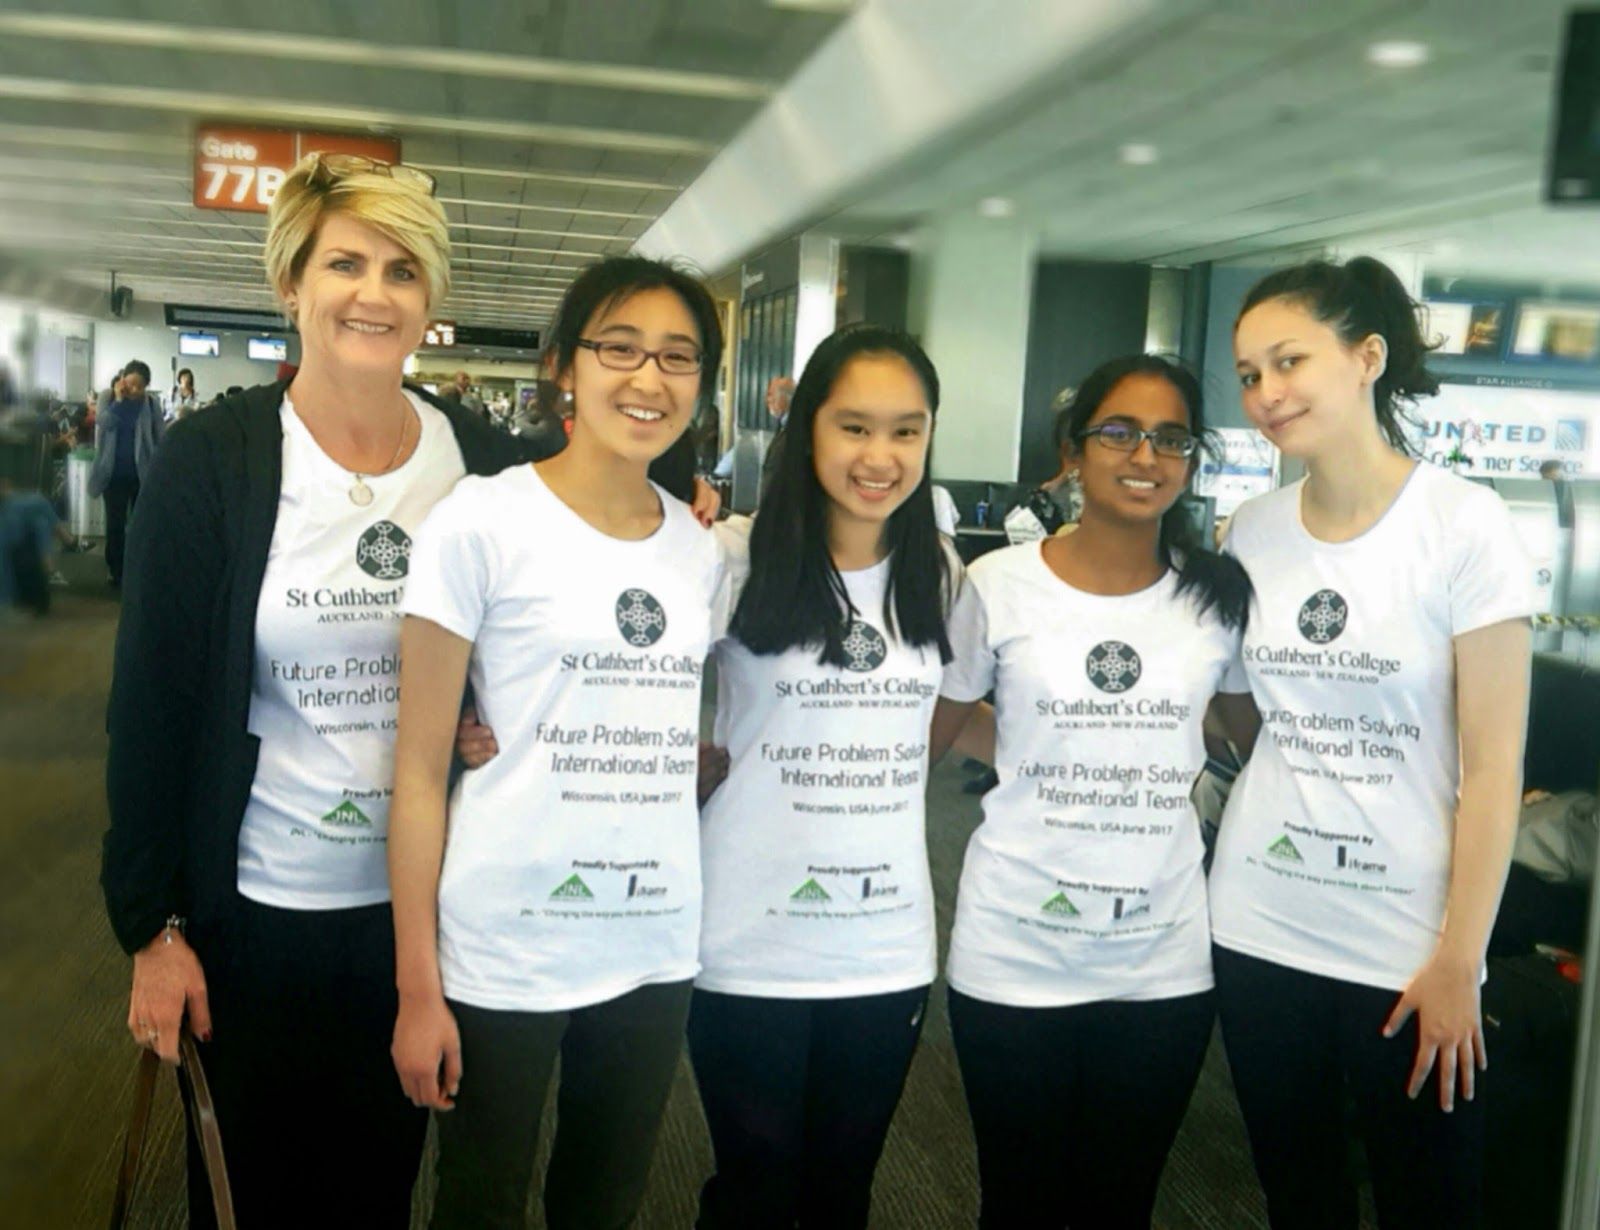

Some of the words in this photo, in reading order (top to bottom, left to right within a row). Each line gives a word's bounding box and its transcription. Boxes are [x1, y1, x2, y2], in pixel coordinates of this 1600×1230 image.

[202, 136, 257, 161] Gate
[202, 163, 286, 206] 77B
[1476, 376, 1499, 386] STAR
[1500, 377, 1543, 388] ALLIANCE
[1431, 450, 1513, 471] Cumer
[1519, 454, 1584, 474] Seice
[286, 588, 308, 607] St
[317, 612, 383, 623] AUCKLAND
[560, 654, 578, 672] St
[583, 652, 657, 672] Cuthbert's
[1256, 645, 1336, 668] Cuthbert's
[1339, 650, 1401, 675] College
[271, 660, 337, 681] Future
[1260, 668, 1310, 679] AUCKLAND
[1337, 672, 1379, 685] ZEALAND
[583, 676, 629, 687] AUCKLAND
[656, 678, 696, 690] ZEALAND
[776, 680, 793, 698] St
[796, 678, 881, 697] Cuthbert's
[800, 700, 852, 709] AUCKLAND
[881, 699, 920, 709] ZEALAND
[1051, 699, 1133, 717] Cuthbert's
[536, 722, 587, 744] Future
[593, 725, 663, 747] Problem
[1054, 720, 1106, 730] AUCKLAND
[1134, 721, 1178, 730] ZEALAND
[1359, 714, 1421, 741] Solving
[762, 743, 811, 762] Future
[818, 743, 889, 762] Problem
[1359, 739, 1405, 762] Team
[551, 753, 656, 775] International
[1072, 763, 1142, 783] Problem
[780, 767, 885, 788] International
[1340, 769, 1364, 782] June
[1366, 773, 1393, 785] 2017
[343, 788, 382, 800] Proudly
[620, 790, 640, 802] USA
[640, 791, 660, 804] June
[661, 791, 682, 802] 2017
[1037, 782, 1138, 808] International
[1145, 791, 1188, 810] Team
[849, 802, 869, 814] USA
[869, 802, 890, 815] June
[1100, 822, 1121, 832] USA
[1122, 823, 1146, 835] June
[1148, 824, 1173, 836] 2017
[1283, 820, 1312, 837] Proudly
[1314, 828, 1360, 843] Supported
[1363, 834, 1374, 846] By
[572, 859, 606, 871] Proudly
[609, 860, 649, 871] Supported
[650, 860, 660, 870] By
[807, 864, 840, 877] Proudly
[842, 864, 881, 875] Supported
[1057, 879, 1089, 892] Proudly
[1092, 883, 1137, 894] Supported
